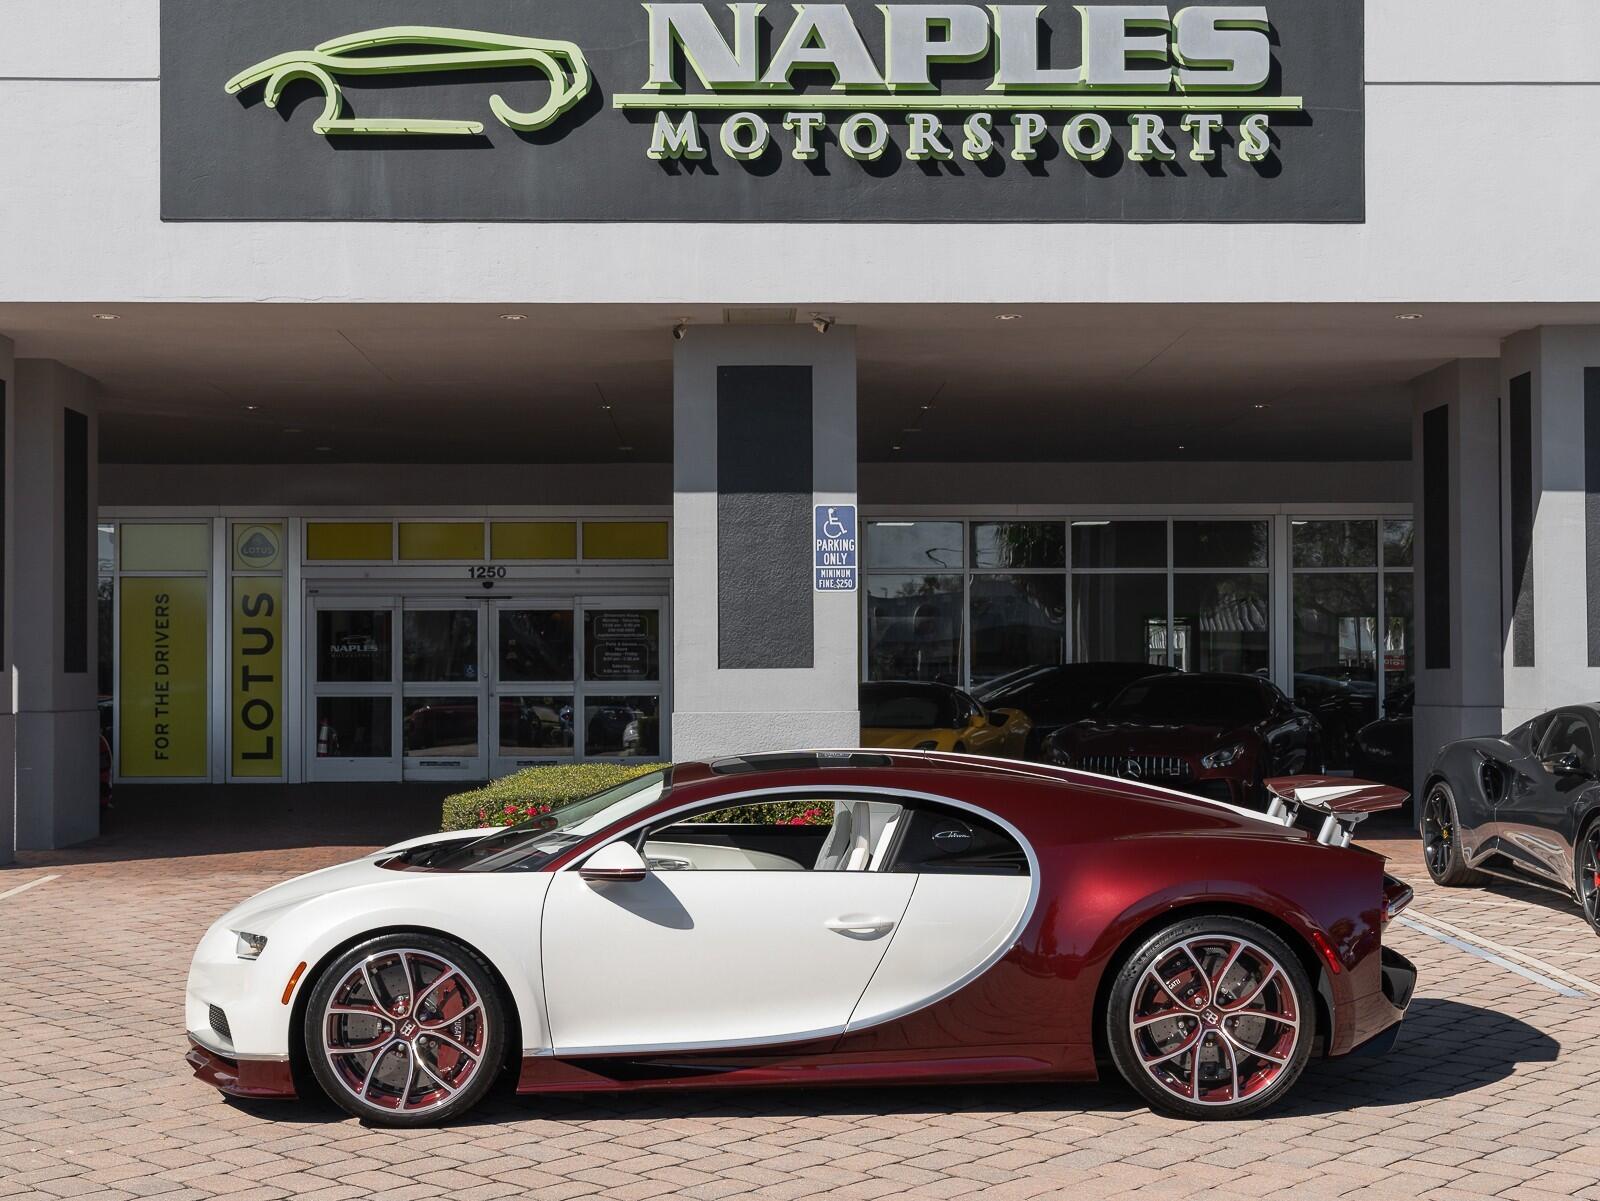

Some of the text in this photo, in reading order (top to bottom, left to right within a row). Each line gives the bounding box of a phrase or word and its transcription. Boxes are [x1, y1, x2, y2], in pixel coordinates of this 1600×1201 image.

[641, 2, 1271, 91] NAPLES
[646, 110, 1271, 161] MOTORSPORTS
[816, 539, 855, 551] PARKING
[823, 553, 848, 565] ONLY
[468, 566, 507, 579] 1250
[820, 569, 851, 578] MINIMUM
[819, 579, 853, 588] FINE $250
[155, 594, 169, 760] FOR THE DRIVERS
[242, 592, 274, 760] LOTUS
